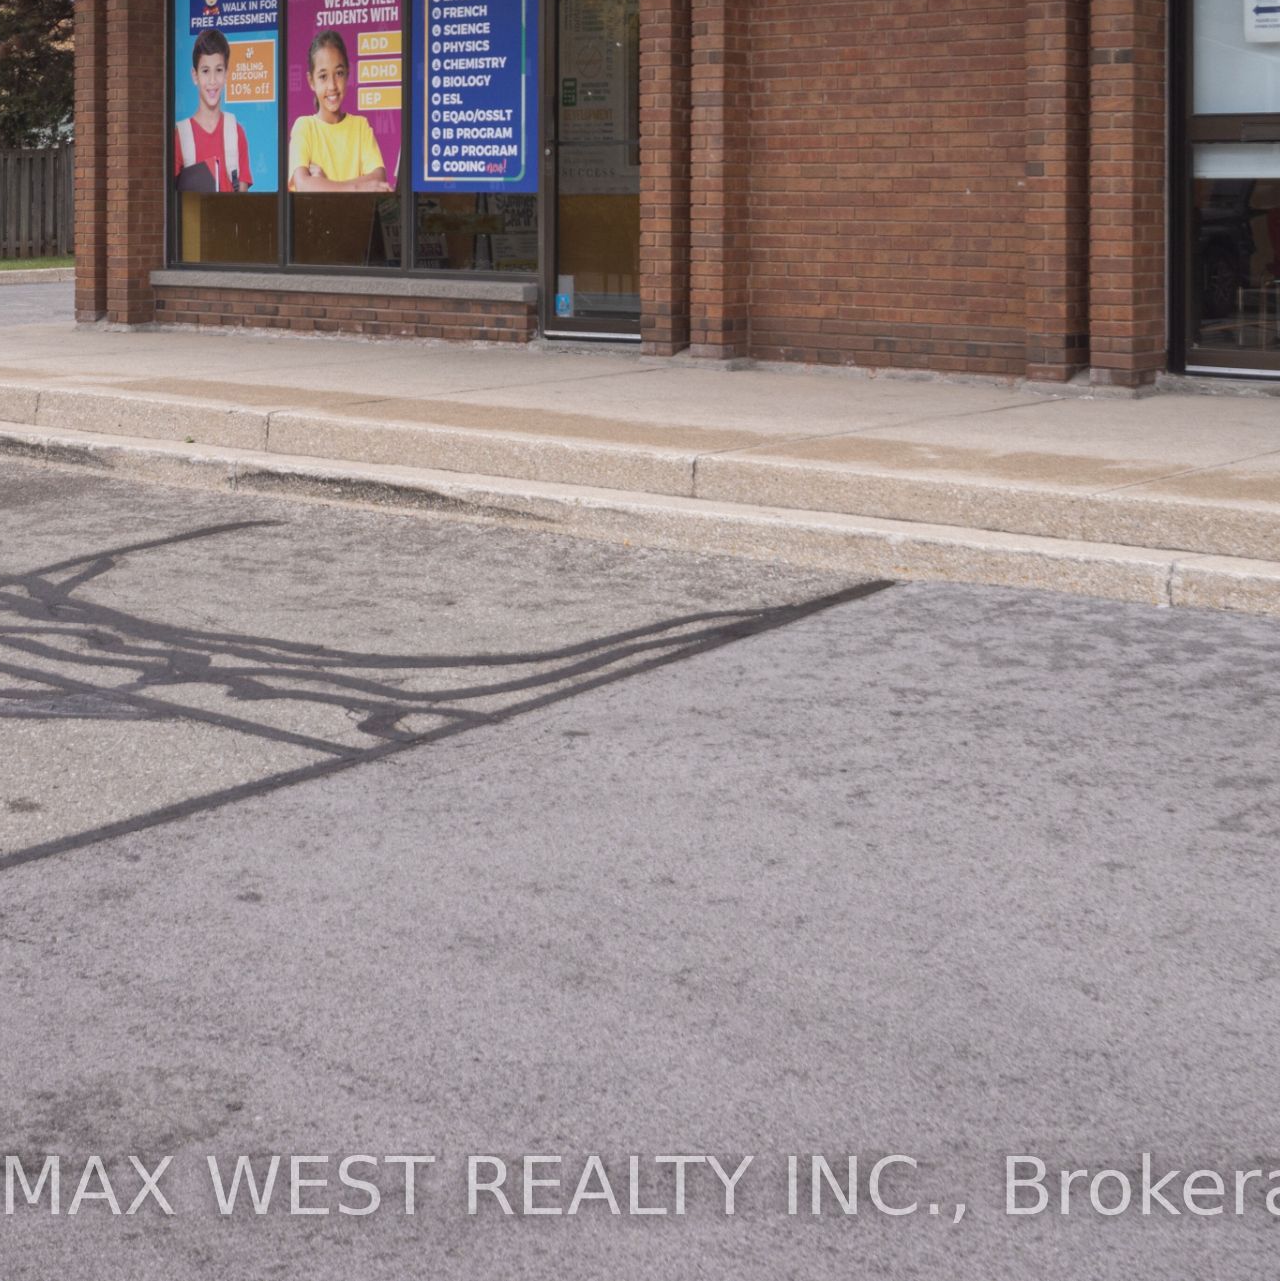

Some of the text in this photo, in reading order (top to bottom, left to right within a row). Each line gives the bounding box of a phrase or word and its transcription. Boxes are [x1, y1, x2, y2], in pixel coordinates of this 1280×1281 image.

[222, 0, 277, 12] WALK IN FOR
[443, 5, 487, 18] FRENCH
[191, 12, 278, 28] FREE ASSESSMENT
[316, 6, 399, 26] STUDENTS WITH
[443, 22, 490, 36] SCIENCE
[361, 37, 389, 50] ADD
[443, 40, 490, 53] PHYSICS
[236, 62, 264, 71] SIBLING
[443, 56, 506, 70] CHEMISTRY
[231, 70, 268, 81] DISCOUNT
[362, 64, 398, 78] ADHD
[443, 75, 491, 88] BIOLOGY
[231, 83, 270, 95] 10% off
[361, 92, 382, 105] IEP
[443, 93, 463, 105] ESL
[443, 109, 513, 124] EQAO/OSSLT
[443, 127, 513, 139] IB PROGRAM
[443, 144, 518, 157] AP PROGRAM
[443, 160, 486, 172] CODING
